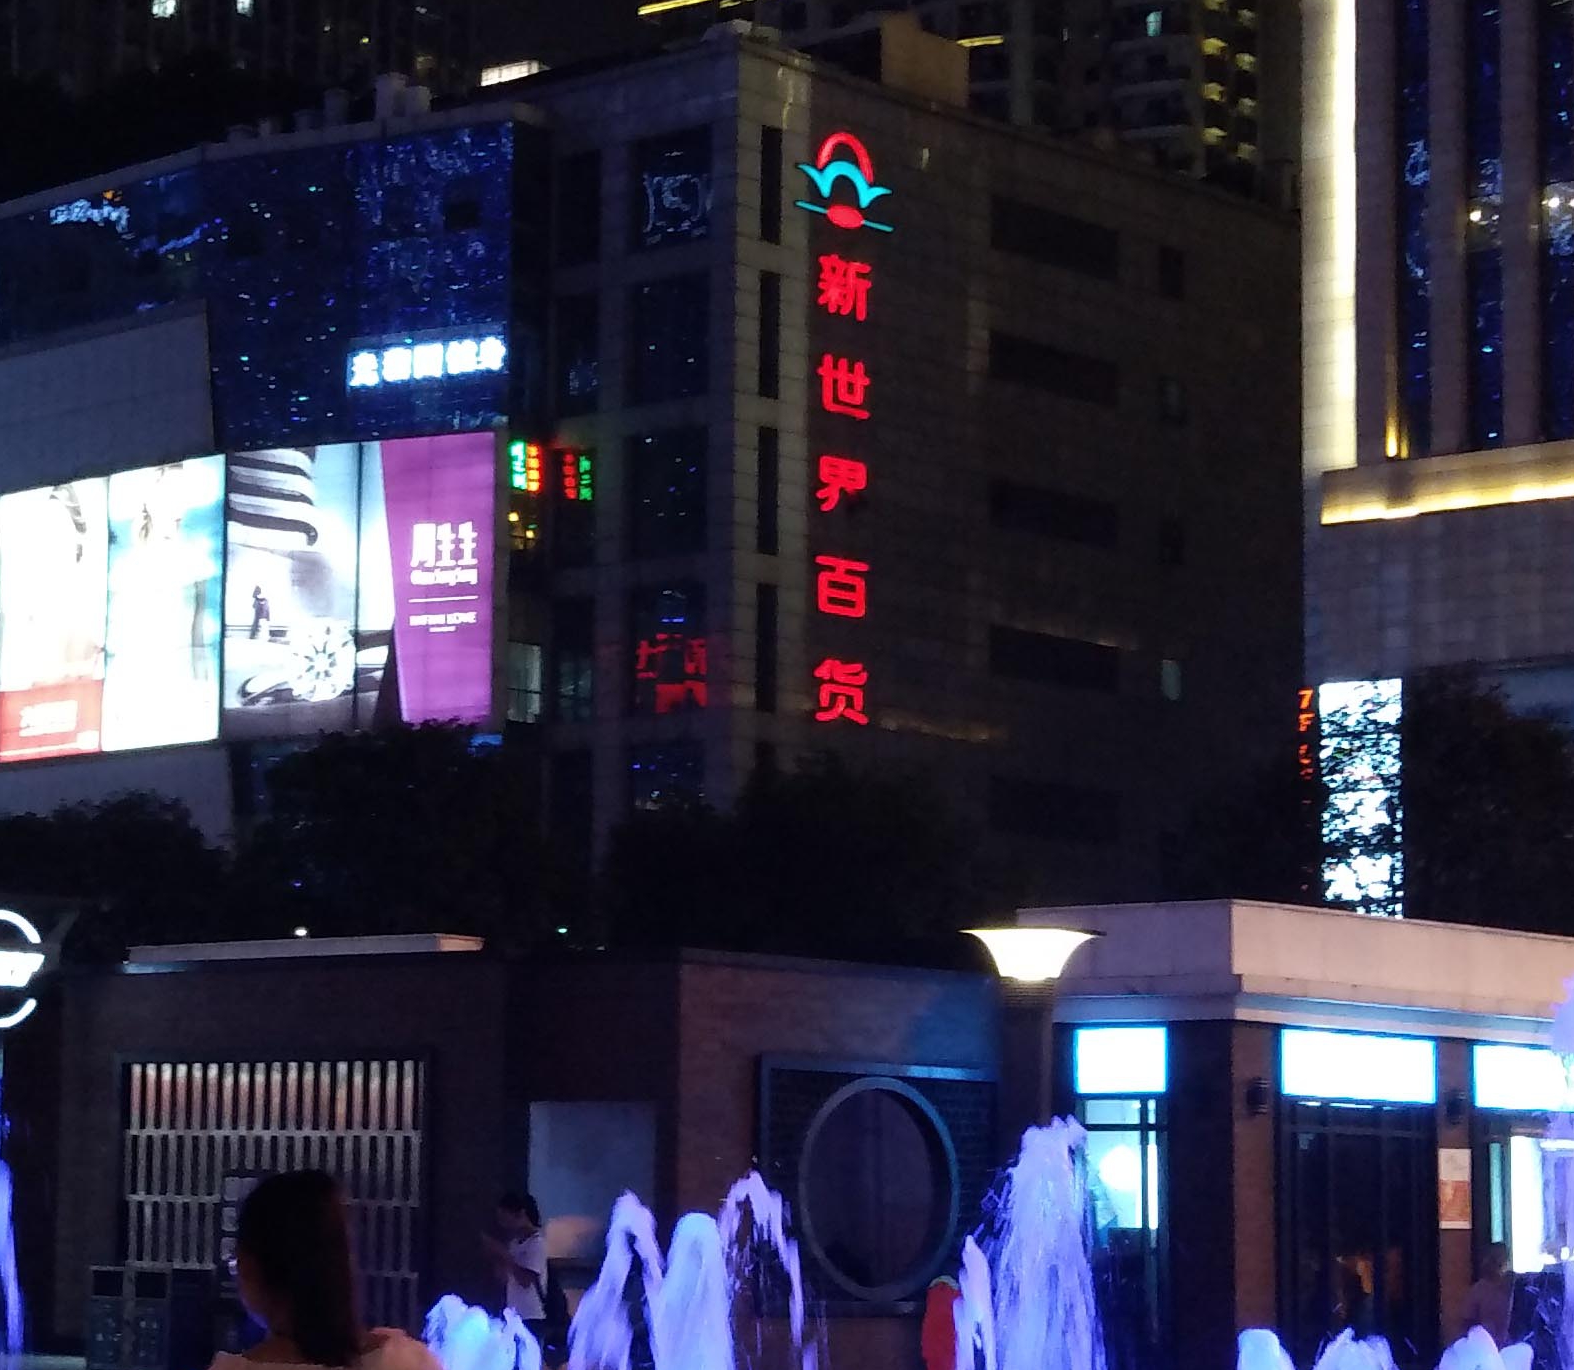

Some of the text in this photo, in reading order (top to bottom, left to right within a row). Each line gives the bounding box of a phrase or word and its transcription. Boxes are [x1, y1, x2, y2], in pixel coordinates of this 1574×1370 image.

[814, 253, 872, 726] 新世界百货
